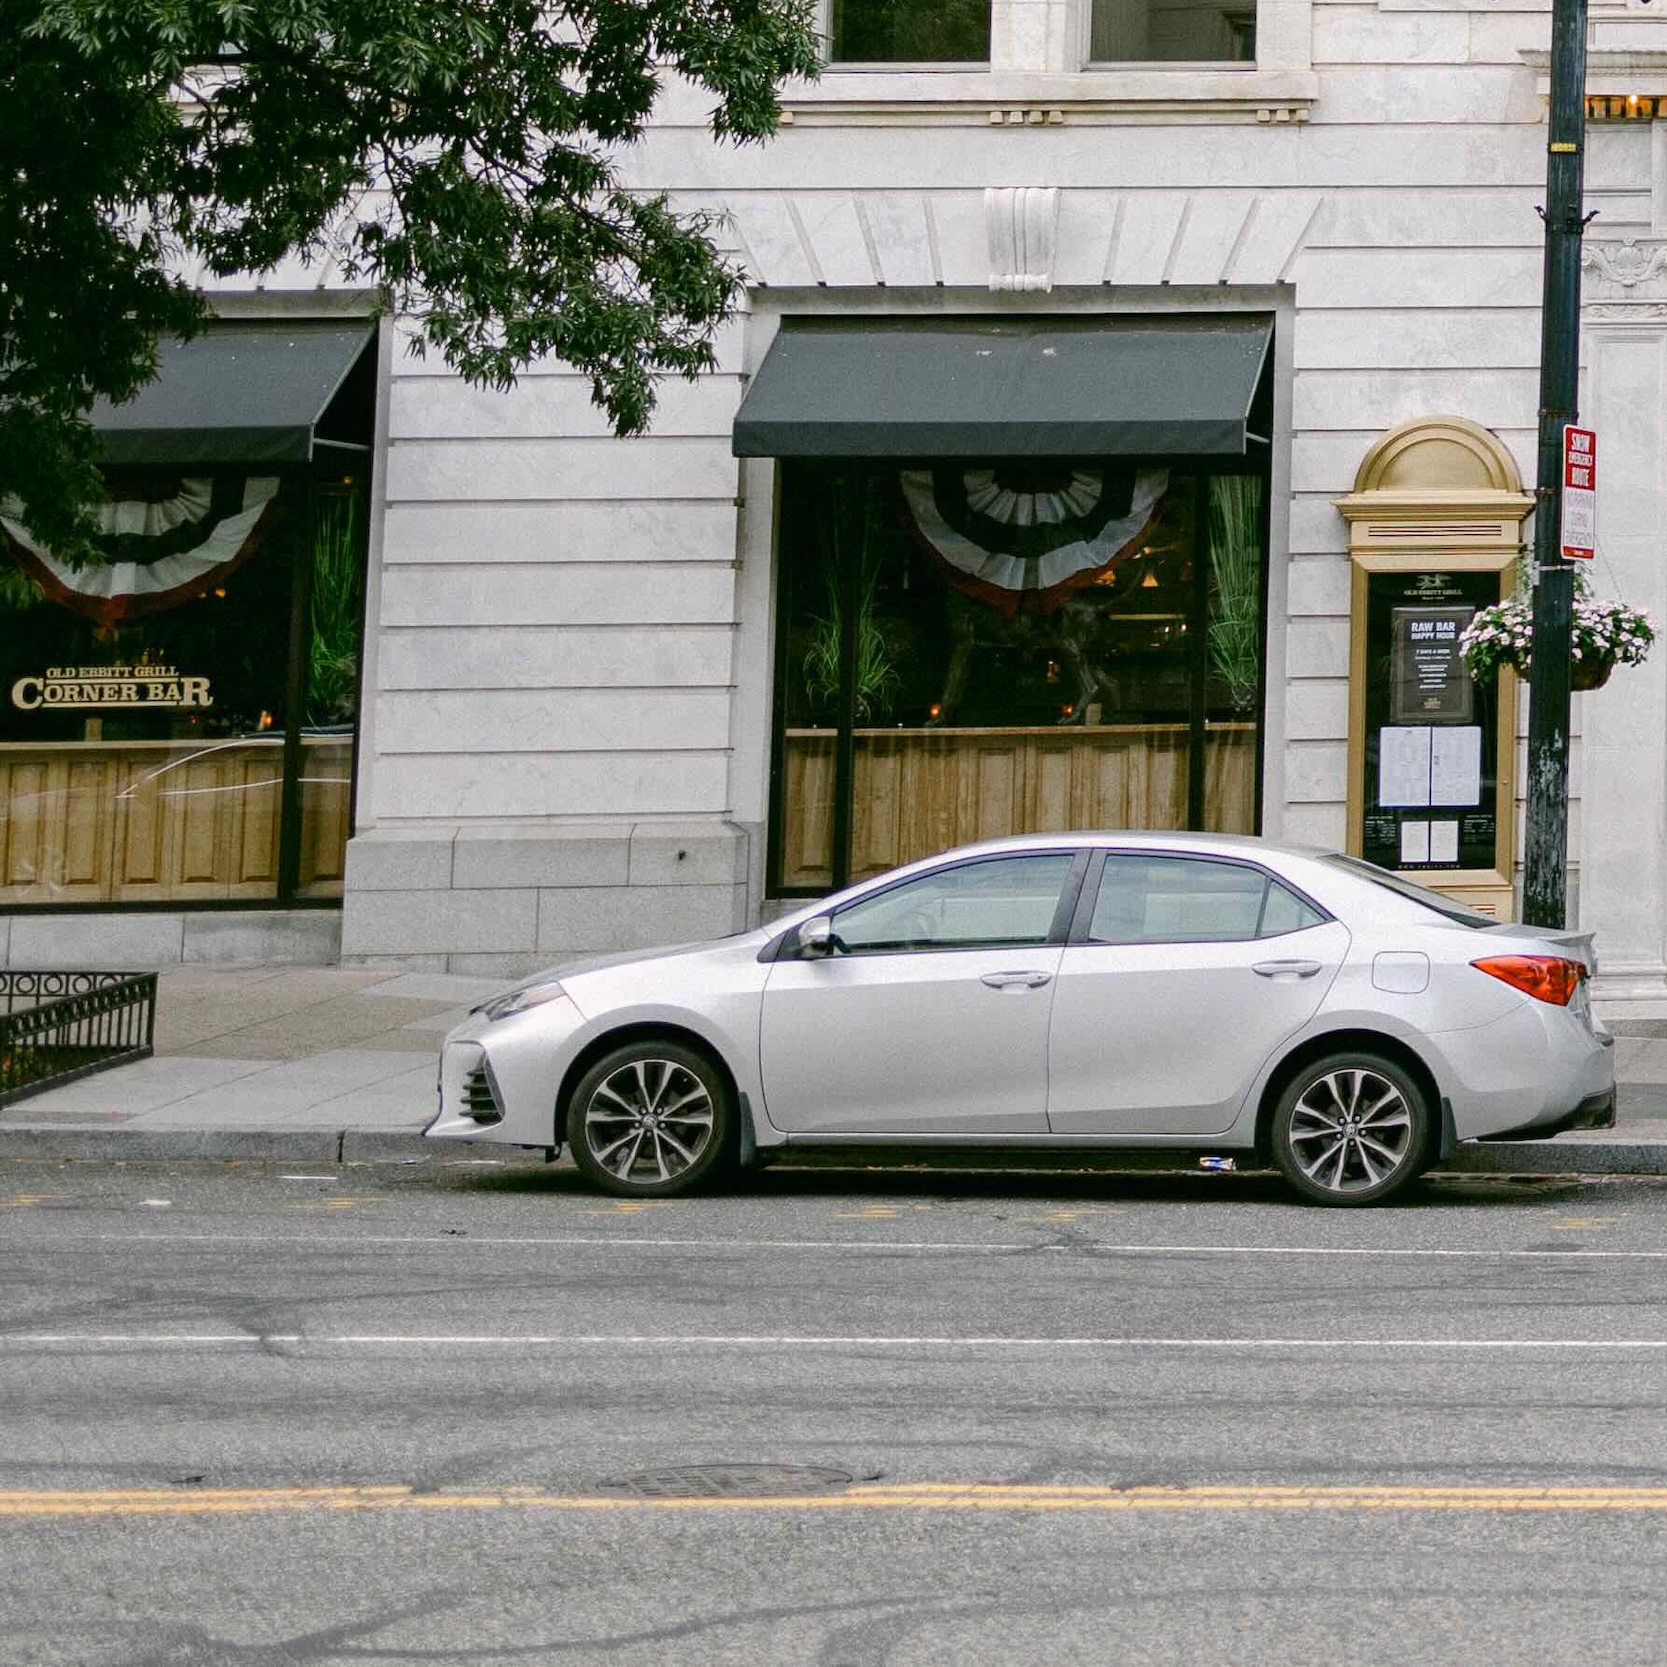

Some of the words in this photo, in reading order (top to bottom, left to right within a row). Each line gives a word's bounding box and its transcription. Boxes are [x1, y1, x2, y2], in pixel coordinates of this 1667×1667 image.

[1411, 622, 1434, 632] RAW
[1436, 622, 1456, 631] BAR
[1411, 632, 1435, 640] HAPPY
[46, 667, 76, 679] OLD
[79, 666, 133, 678] EBBITT
[134, 666, 180, 677] GRILL
[11, 677, 140, 710] CORNER
[146, 676, 214, 707] BAR
